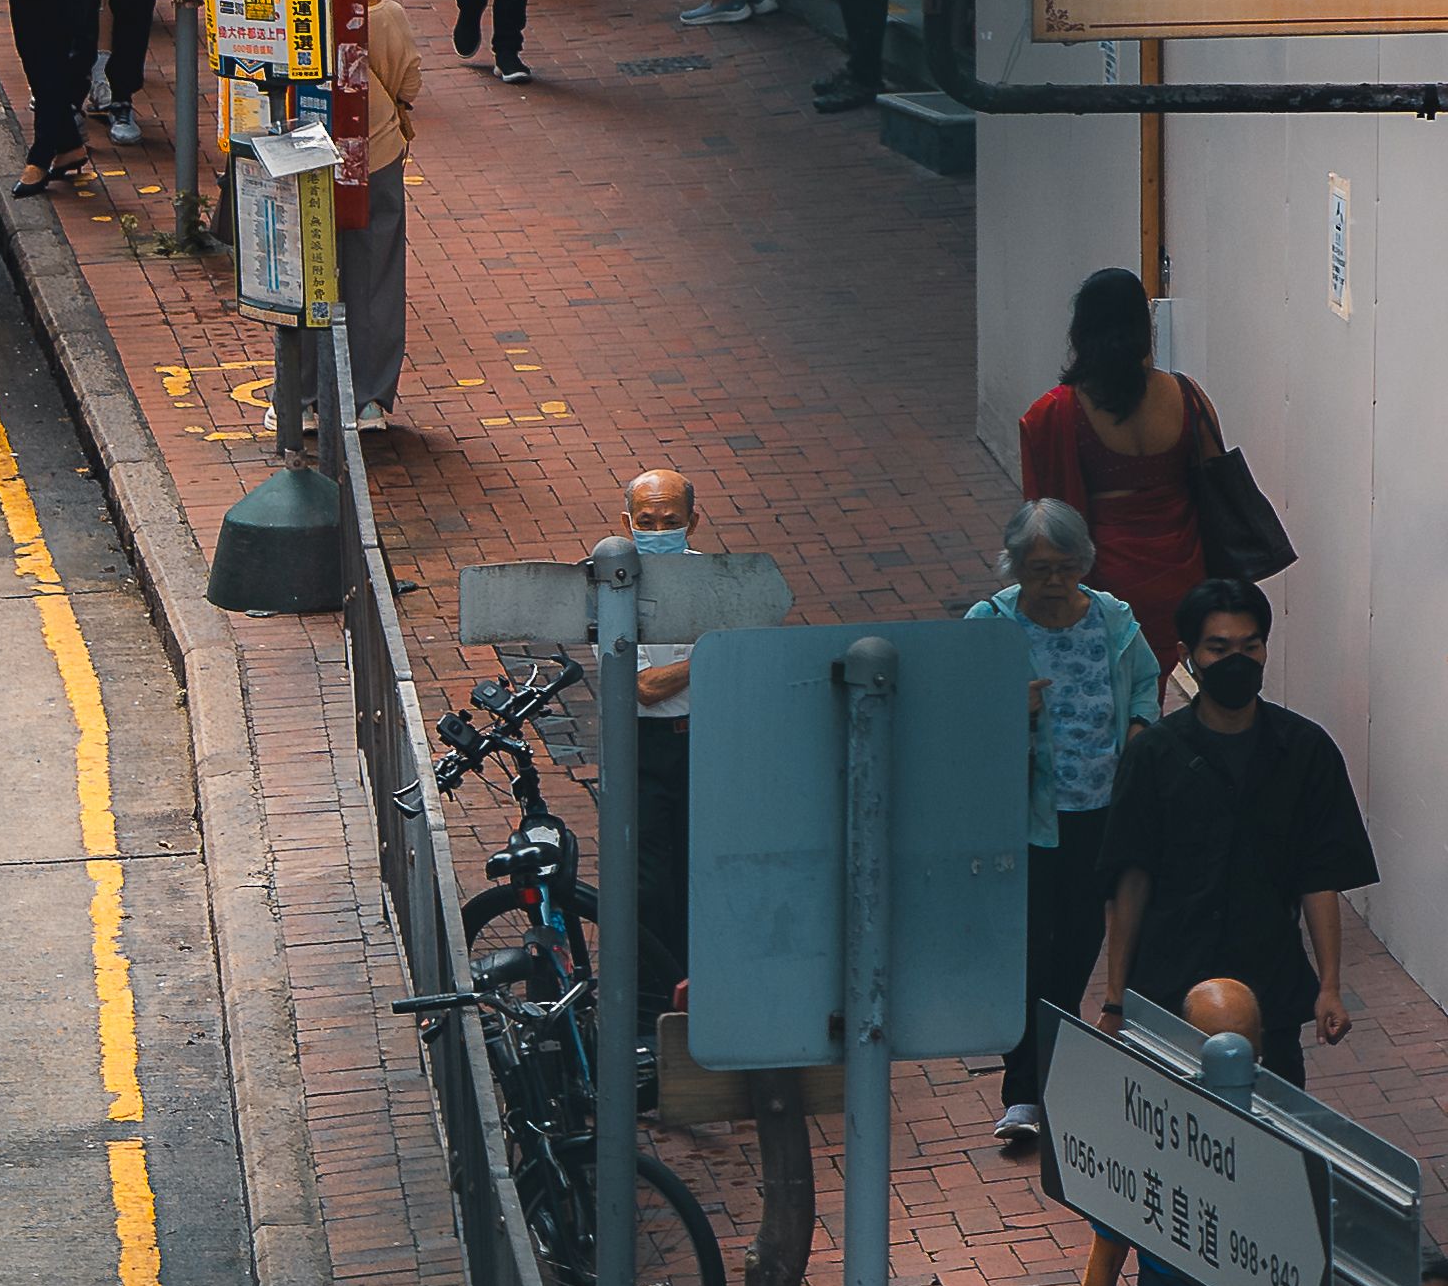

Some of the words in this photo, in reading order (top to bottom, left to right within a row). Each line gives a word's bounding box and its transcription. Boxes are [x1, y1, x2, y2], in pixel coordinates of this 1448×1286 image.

[1124, 1076, 1180, 1151] King's
[1187, 1112, 1236, 1182] Road
[1063, 1132, 1096, 1179] 1056
[1107, 1157, 1137, 1203] 1010
[1143, 1167, 1220, 1270] 英皇道
[1229, 1230, 1258, 1276] 998
